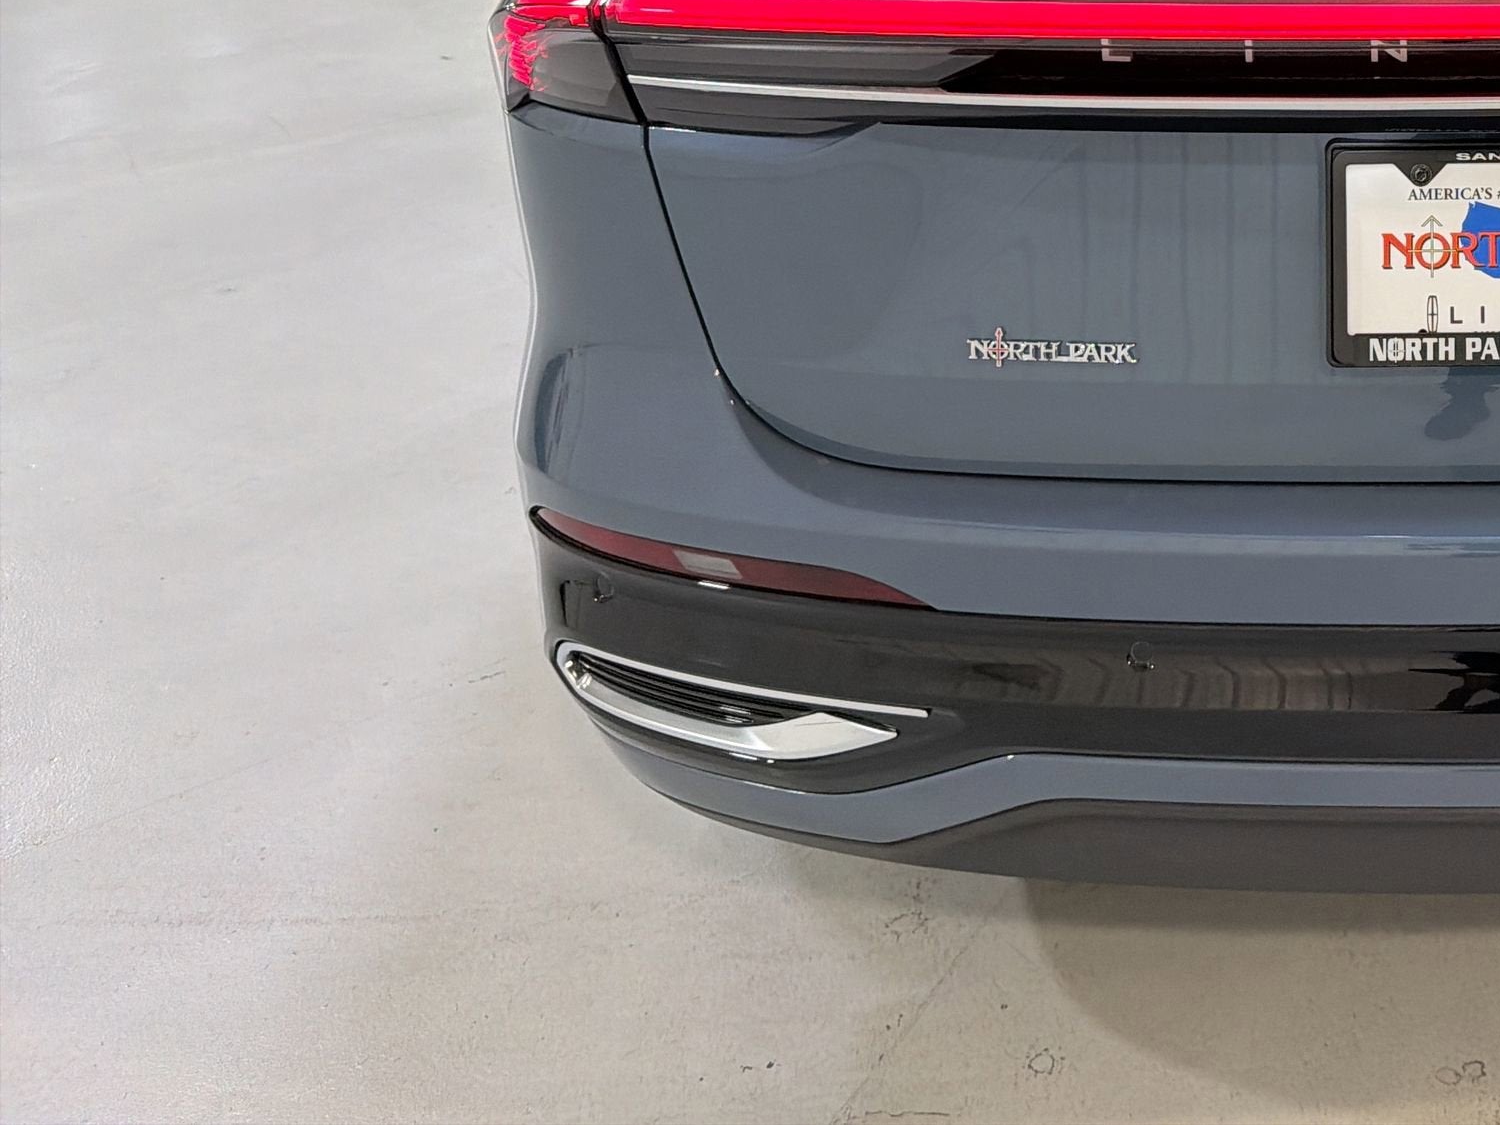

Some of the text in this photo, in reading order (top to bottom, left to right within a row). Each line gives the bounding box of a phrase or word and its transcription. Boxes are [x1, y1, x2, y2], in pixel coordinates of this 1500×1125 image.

[1408, 187, 1493, 201] AMERICA'S
[967, 338, 1139, 364] NORTH PARK
[1369, 337, 1456, 362] NORTH
